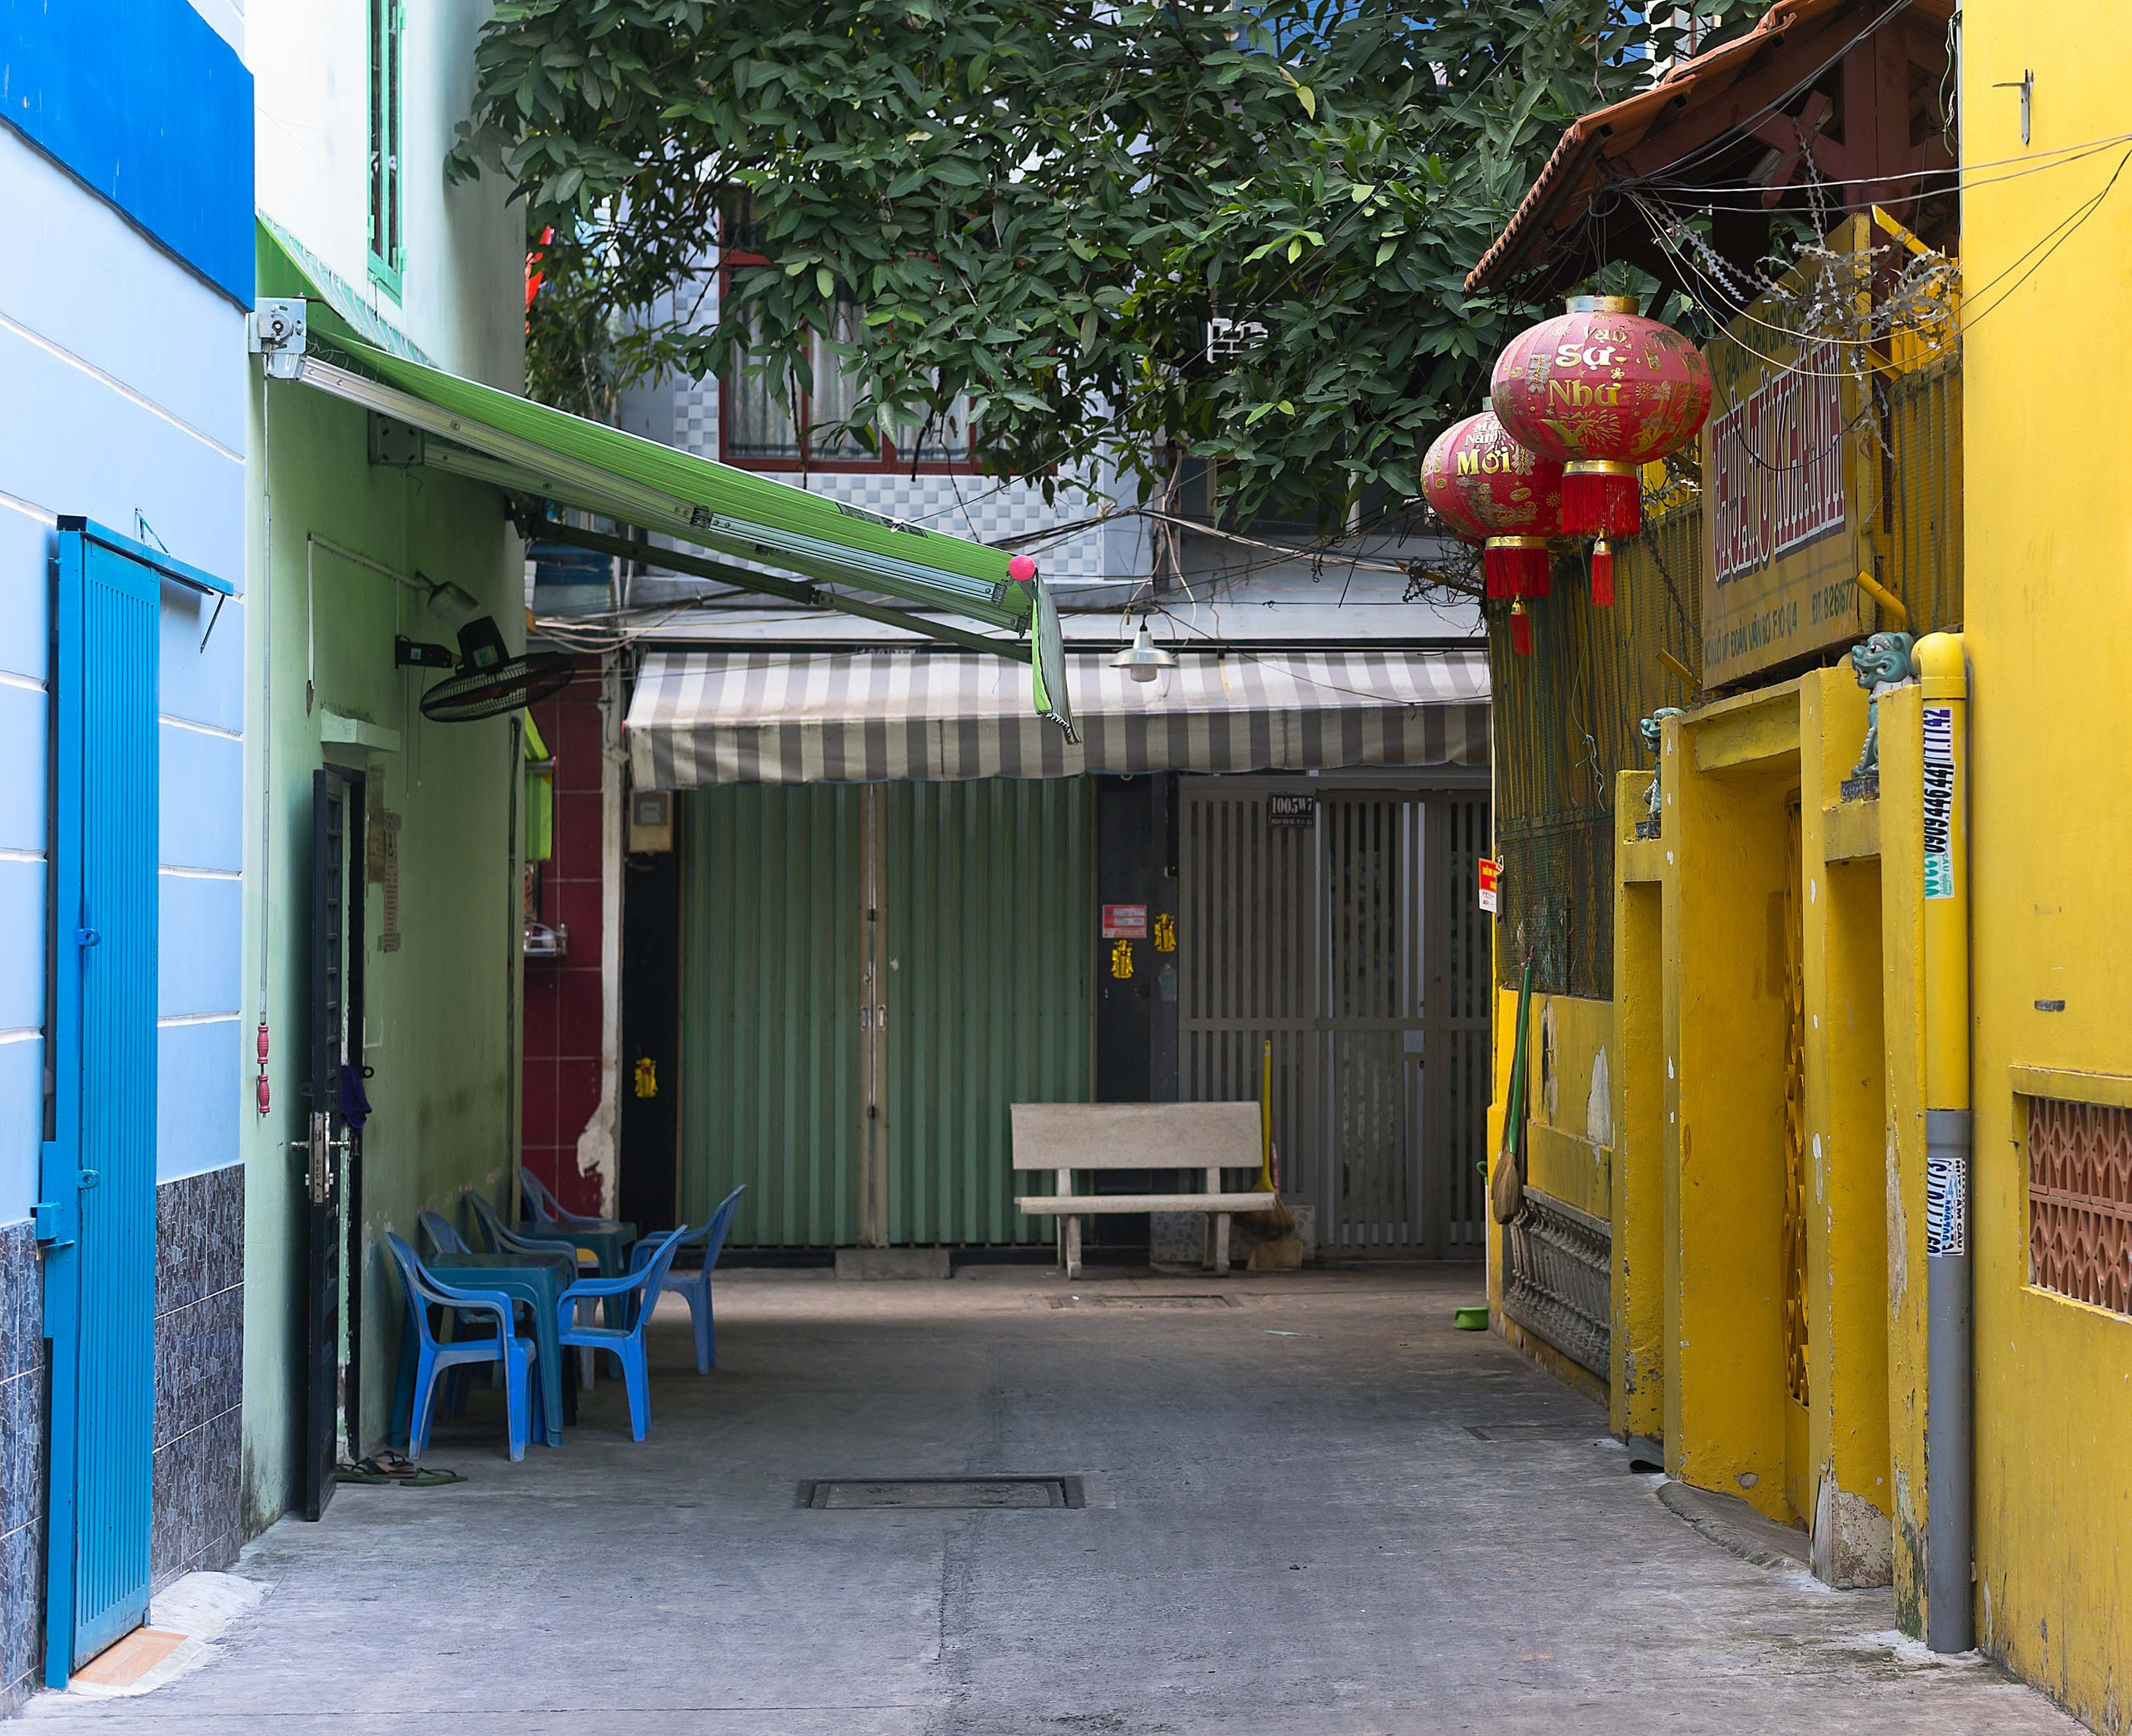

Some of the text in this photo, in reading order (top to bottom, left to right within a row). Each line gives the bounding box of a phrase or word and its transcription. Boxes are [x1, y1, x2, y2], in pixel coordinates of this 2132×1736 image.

[1583, 326, 1628, 344] Vạn
[1555, 343, 1616, 371] Sự
[1548, 380, 1621, 408] Như
[1457, 445, 1511, 476] Mới
[1712, 334, 1845, 584] CHÙA TỪ KHÁNH
[1924, 763, 1955, 854] 0909.446.441
